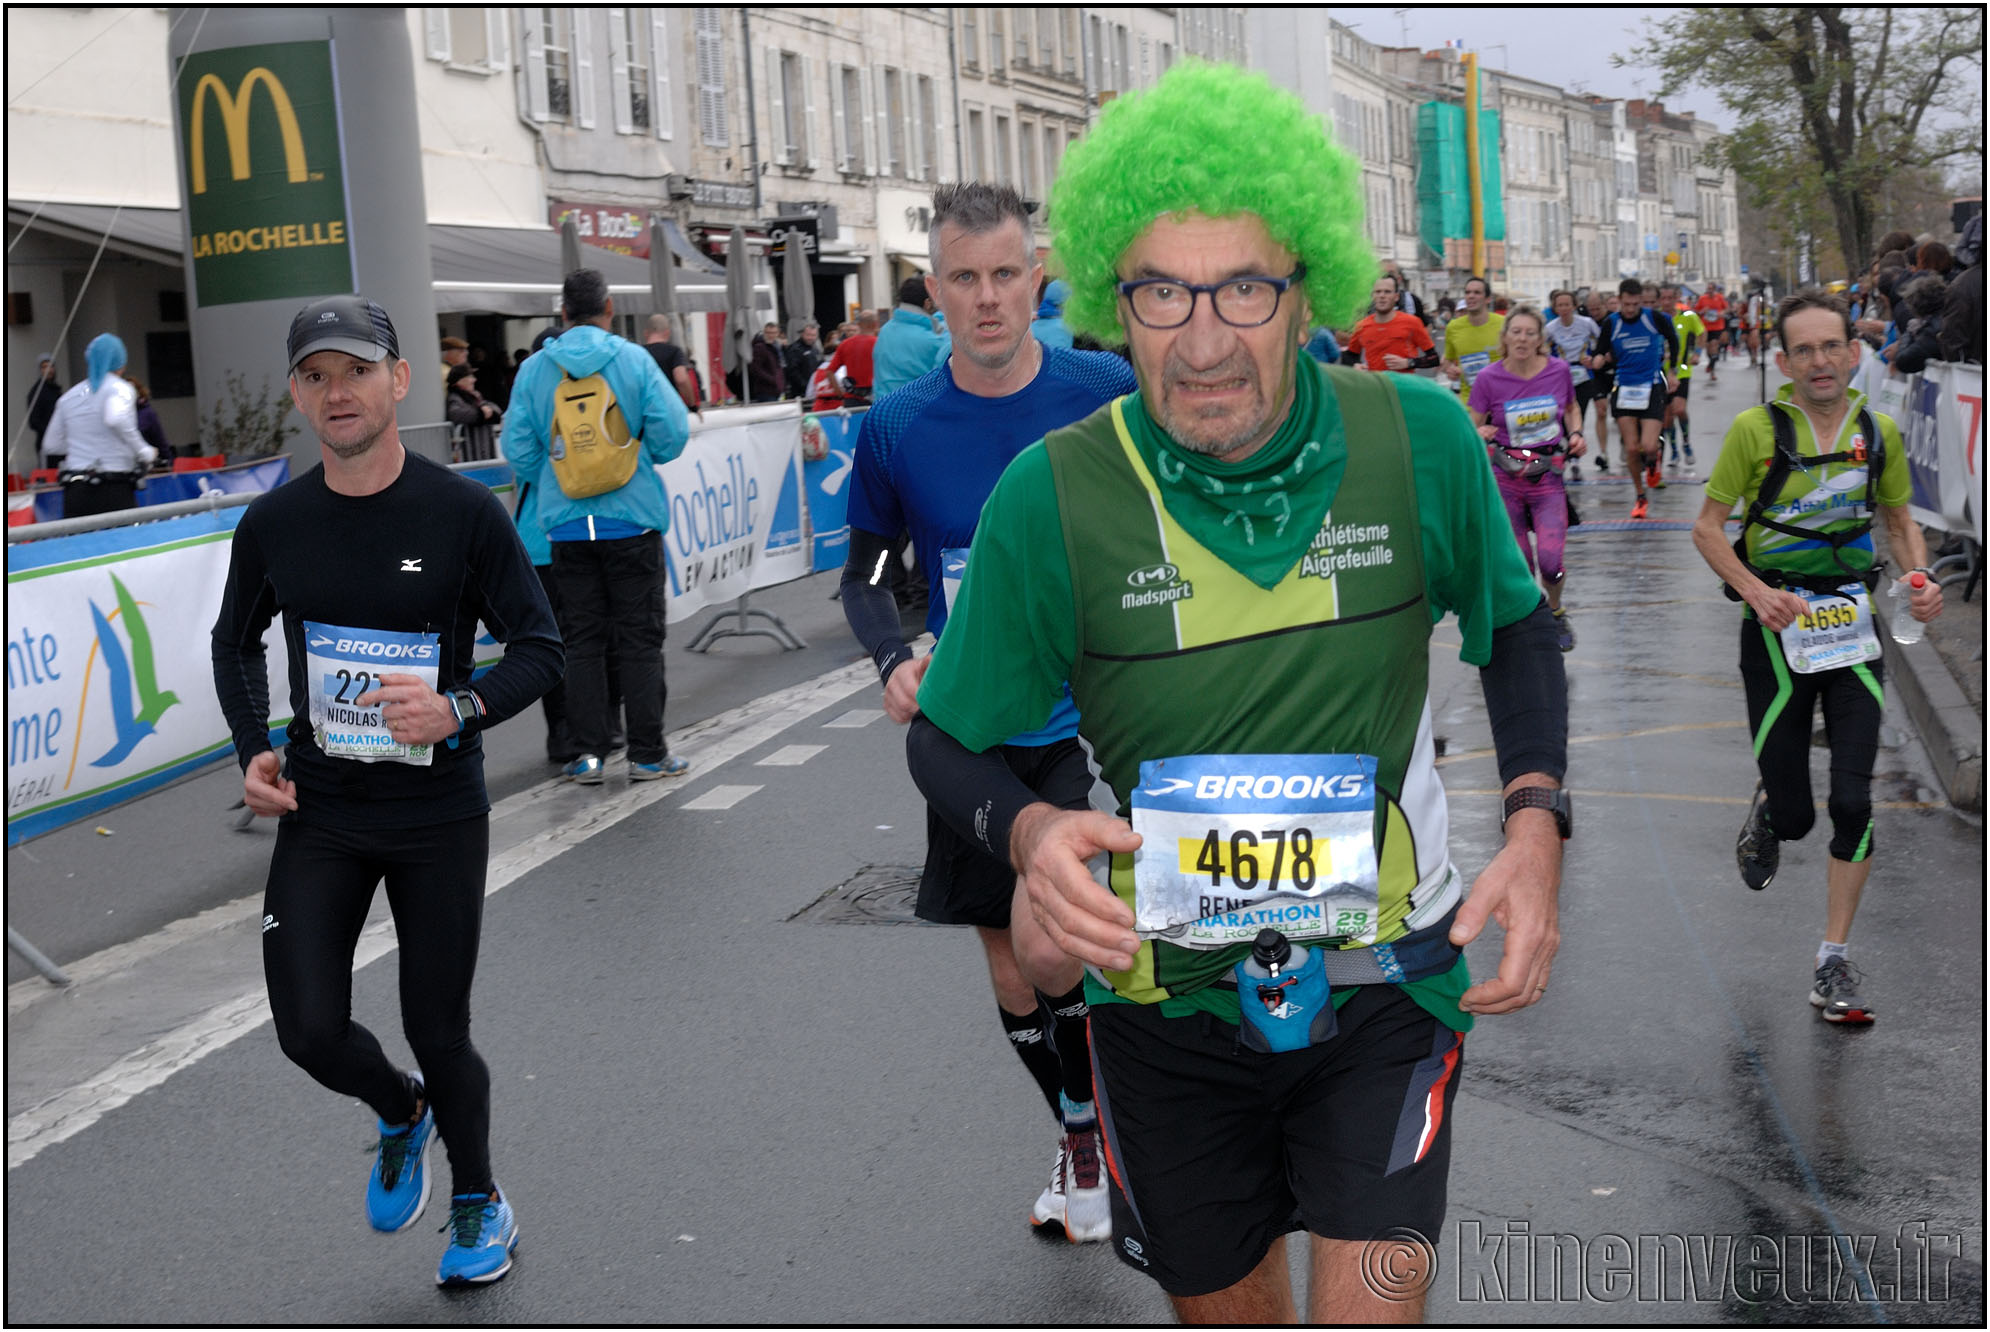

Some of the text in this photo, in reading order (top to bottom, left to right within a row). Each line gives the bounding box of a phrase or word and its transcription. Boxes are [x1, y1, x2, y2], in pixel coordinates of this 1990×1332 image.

[192, 221, 345, 258] LA ROCHELLE
[1310, 524, 1389, 549] thlétisme
[1301, 544, 1393, 577] Aigrefeuille
[1122, 582, 1191, 609] Madsport
[1803, 602, 1852, 632] 4635
[335, 638, 433, 658] BROOKS
[334, 669, 386, 708] 227
[327, 707, 378, 728] NICOLAS
[10, 707, 61, 767] me
[1195, 774, 1366, 799] BROOKS
[1196, 828, 1317, 891] 4678
[1191, 904, 1321, 928] MARATHON
[1336, 911, 1368, 927] 29
[1224, 920, 1321, 939] ROCELLE
